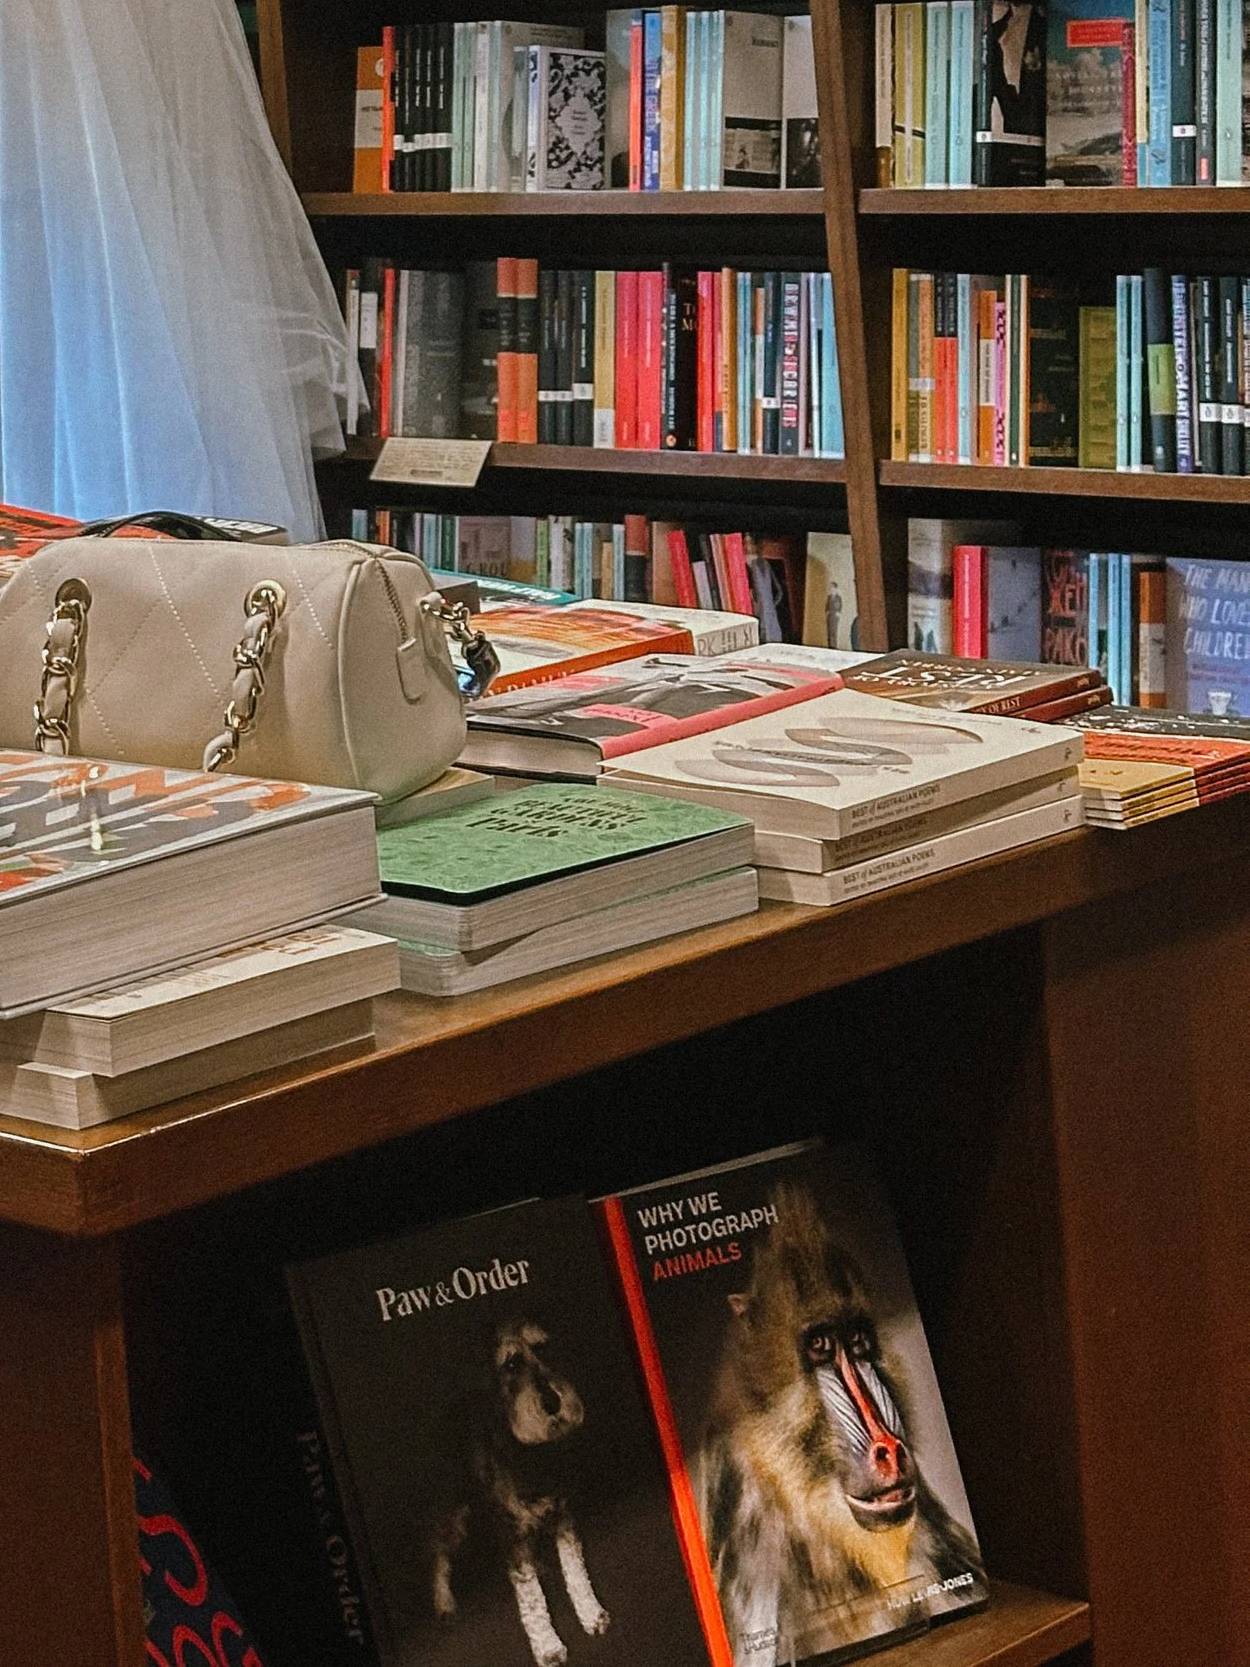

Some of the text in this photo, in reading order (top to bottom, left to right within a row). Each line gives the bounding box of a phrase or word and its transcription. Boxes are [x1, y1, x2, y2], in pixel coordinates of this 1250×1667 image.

[1184, 564, 1213, 586] THE
[1210, 598, 1250, 626] LOVE
[1184, 627, 1250, 661] CHILDRE
[1000, 696, 1022, 711] REST
[851, 805, 869, 820] BEST
[876, 791, 918, 811] AUSTRALIAN
[918, 783, 941, 798] POEMS
[465, 817, 570, 838] Paris
[842, 870, 860, 885] BEST
[868, 856, 912, 876] AUSTRALIAN
[912, 848, 936, 863] POEMS
[636, 1191, 723, 1230] WHY WE
[644, 1203, 780, 1256] PHOTOGRAPH
[652, 1240, 743, 1282] ANIMALS
[375, 1256, 530, 1322] Paw & Order
